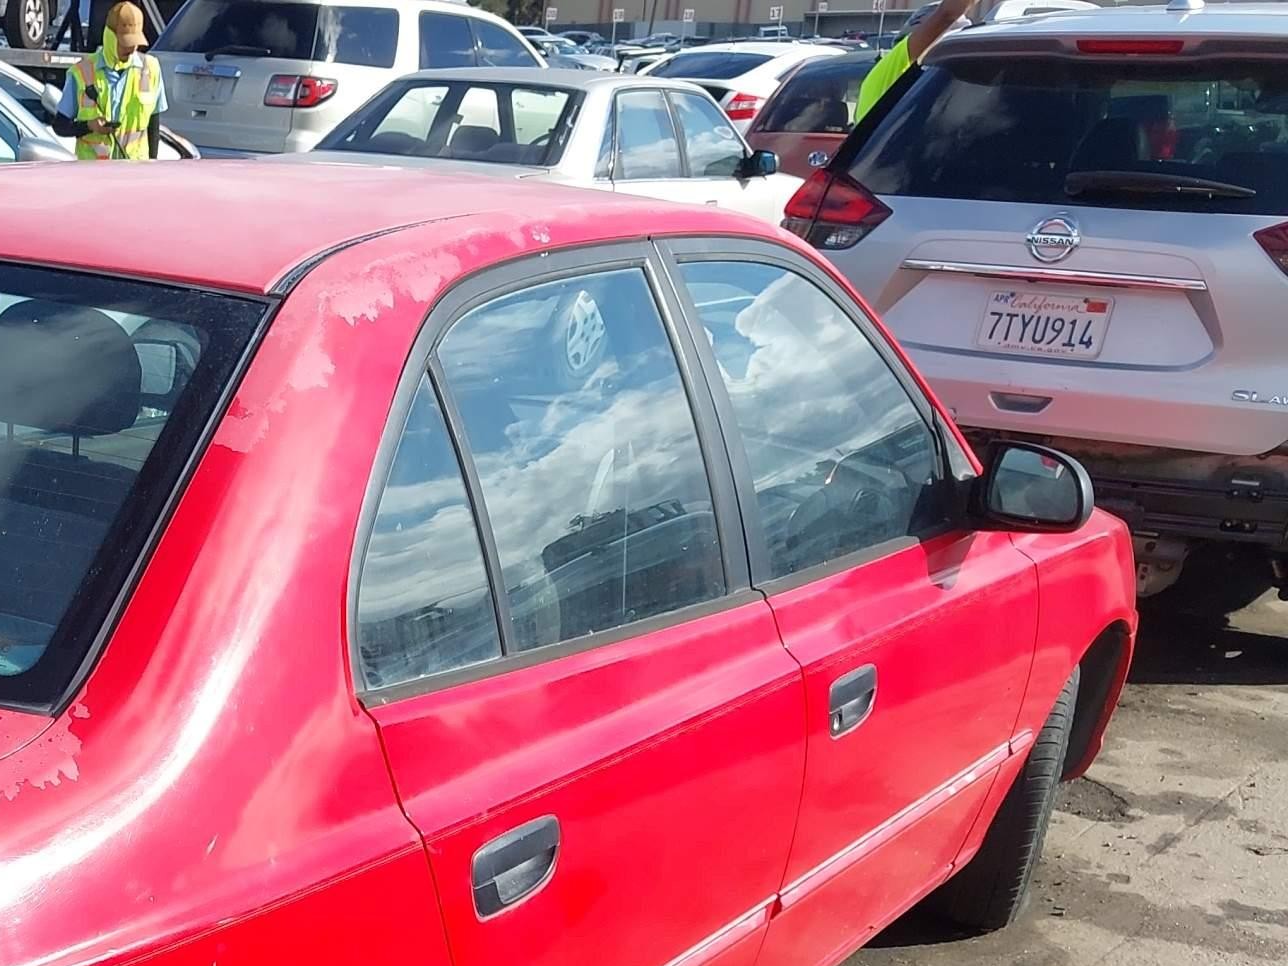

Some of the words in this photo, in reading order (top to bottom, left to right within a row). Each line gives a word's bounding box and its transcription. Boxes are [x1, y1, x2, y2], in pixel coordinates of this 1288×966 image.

[1032, 236, 1074, 246] NISSAN
[994, 293, 1010, 304] APR
[1010, 295, 1086, 314] California
[988, 311, 1093, 349] 7TYU914
